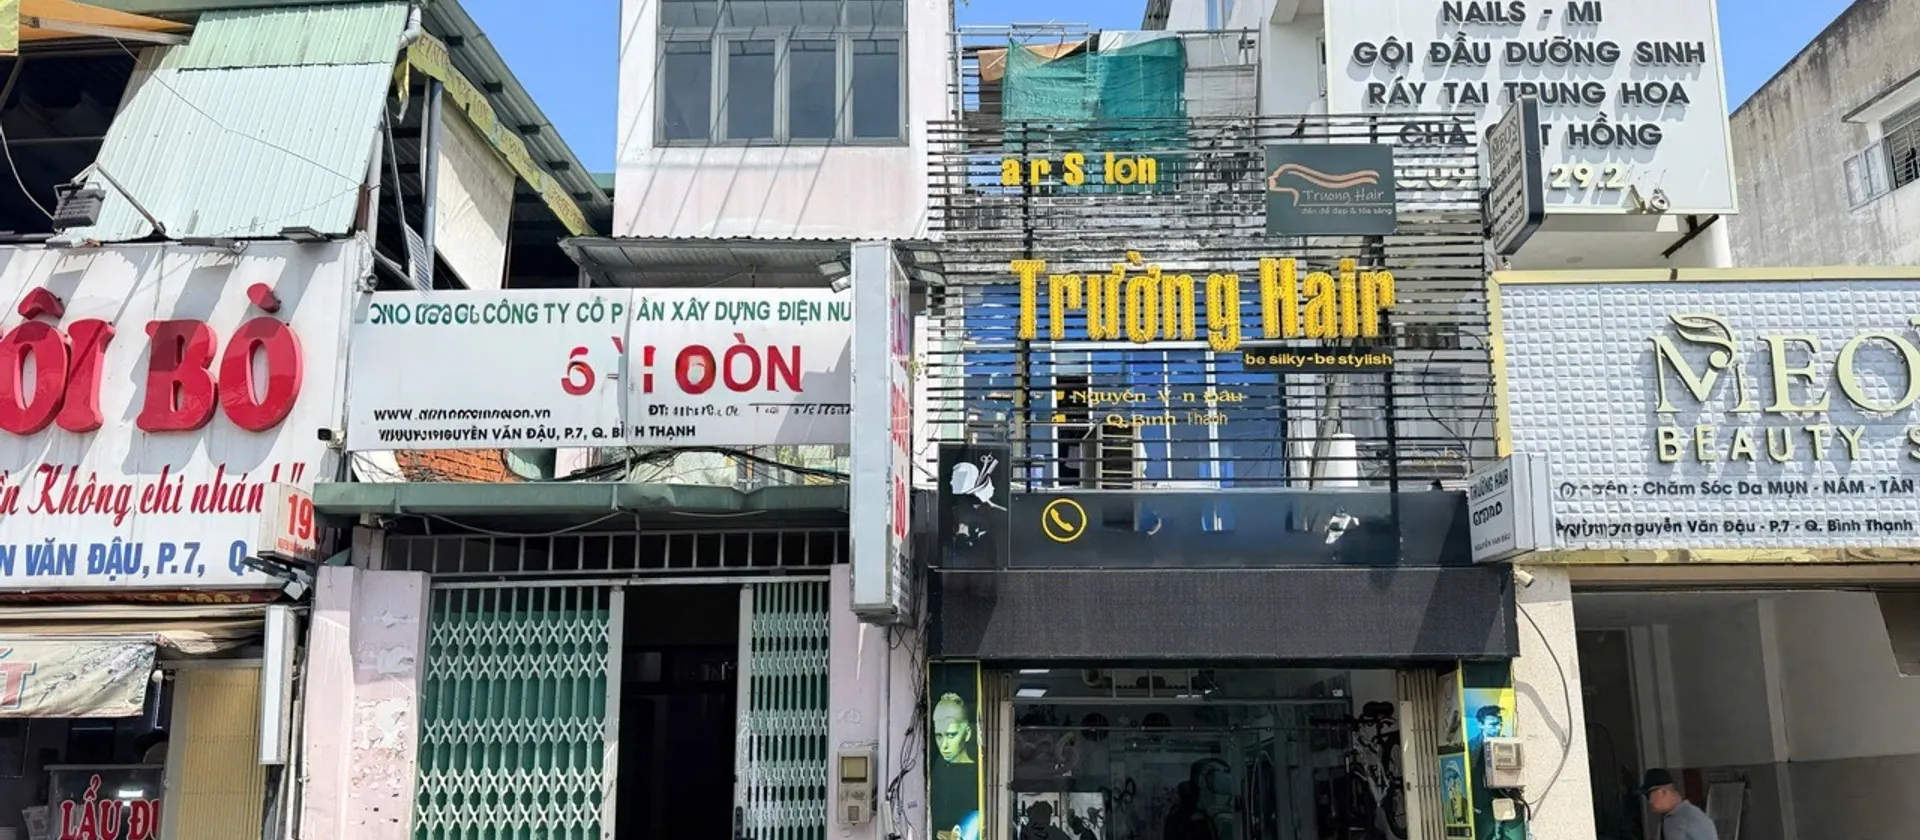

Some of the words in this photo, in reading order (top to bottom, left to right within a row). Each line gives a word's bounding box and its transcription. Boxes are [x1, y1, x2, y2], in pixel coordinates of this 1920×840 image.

[1443, 0, 1526, 24] NAILS
[1568, 2, 1602, 24] MI
[1353, 36, 1414, 71] GỘI
[1429, 32, 1491, 64] ĐẦU
[1506, 36, 1621, 64] DƯỠNG
[1635, 41, 1706, 65] SINH
[1368, 77, 1427, 105] RÁY
[1443, 83, 1488, 104] TAI
[1621, 83, 1690, 105] HOA
[1568, 112, 1662, 146] HỒNG
[1355, 187, 1384, 202] Hair
[483, 298, 538, 324] CÔNG
[544, 303, 570, 324] TY
[577, 296, 605, 323] CỔ
[671, 297, 710, 321] XÂY
[715, 301, 770, 325] DỰNG
[777, 299, 822, 326] ĐIỆN
[1011, 251, 1240, 352] Trường
[1258, 258, 1396, 339] Hair
[0, 286, 116, 435] ÔI
[136, 282, 304, 434] BÒ
[1245, 353, 1266, 365] be
[1338, 353, 1393, 367] stylish
[1648, 314, 1920, 415] MEO
[492, 425, 522, 440] VĂN
[526, 425, 560, 442] ĐẬU,
[565, 427, 587, 440] P.7,
[592, 427, 608, 439] Q.
[612, 421, 645, 438] BÌH
[649, 425, 696, 440] THẠNH
[1657, 424, 1866, 463] BEAUTY
[27, 463, 132, 527] Không
[139, 463, 182, 514] chi
[1643, 481, 1695, 495] Chăm
[1701, 480, 1733, 495] Sóc
[1738, 482, 1762, 495] Da
[1768, 481, 1808, 498] MỤN
[1824, 476, 1865, 495] NÁM
[1879, 476, 1914, 494] TÀN
[1687, 519, 1718, 532] Văn
[1723, 520, 1755, 535] Đậu
[1769, 520, 1790, 532] P.7
[1804, 520, 1823, 532] Q.
[1828, 518, 1861, 532] Bình
[1865, 519, 1913, 535] Thạnh
[26, 537, 77, 576] VĂN
[87, 536, 149, 581] ĐẬU,
[157, 542, 205, 577] P.7,
[59, 774, 123, 840] LẨU
